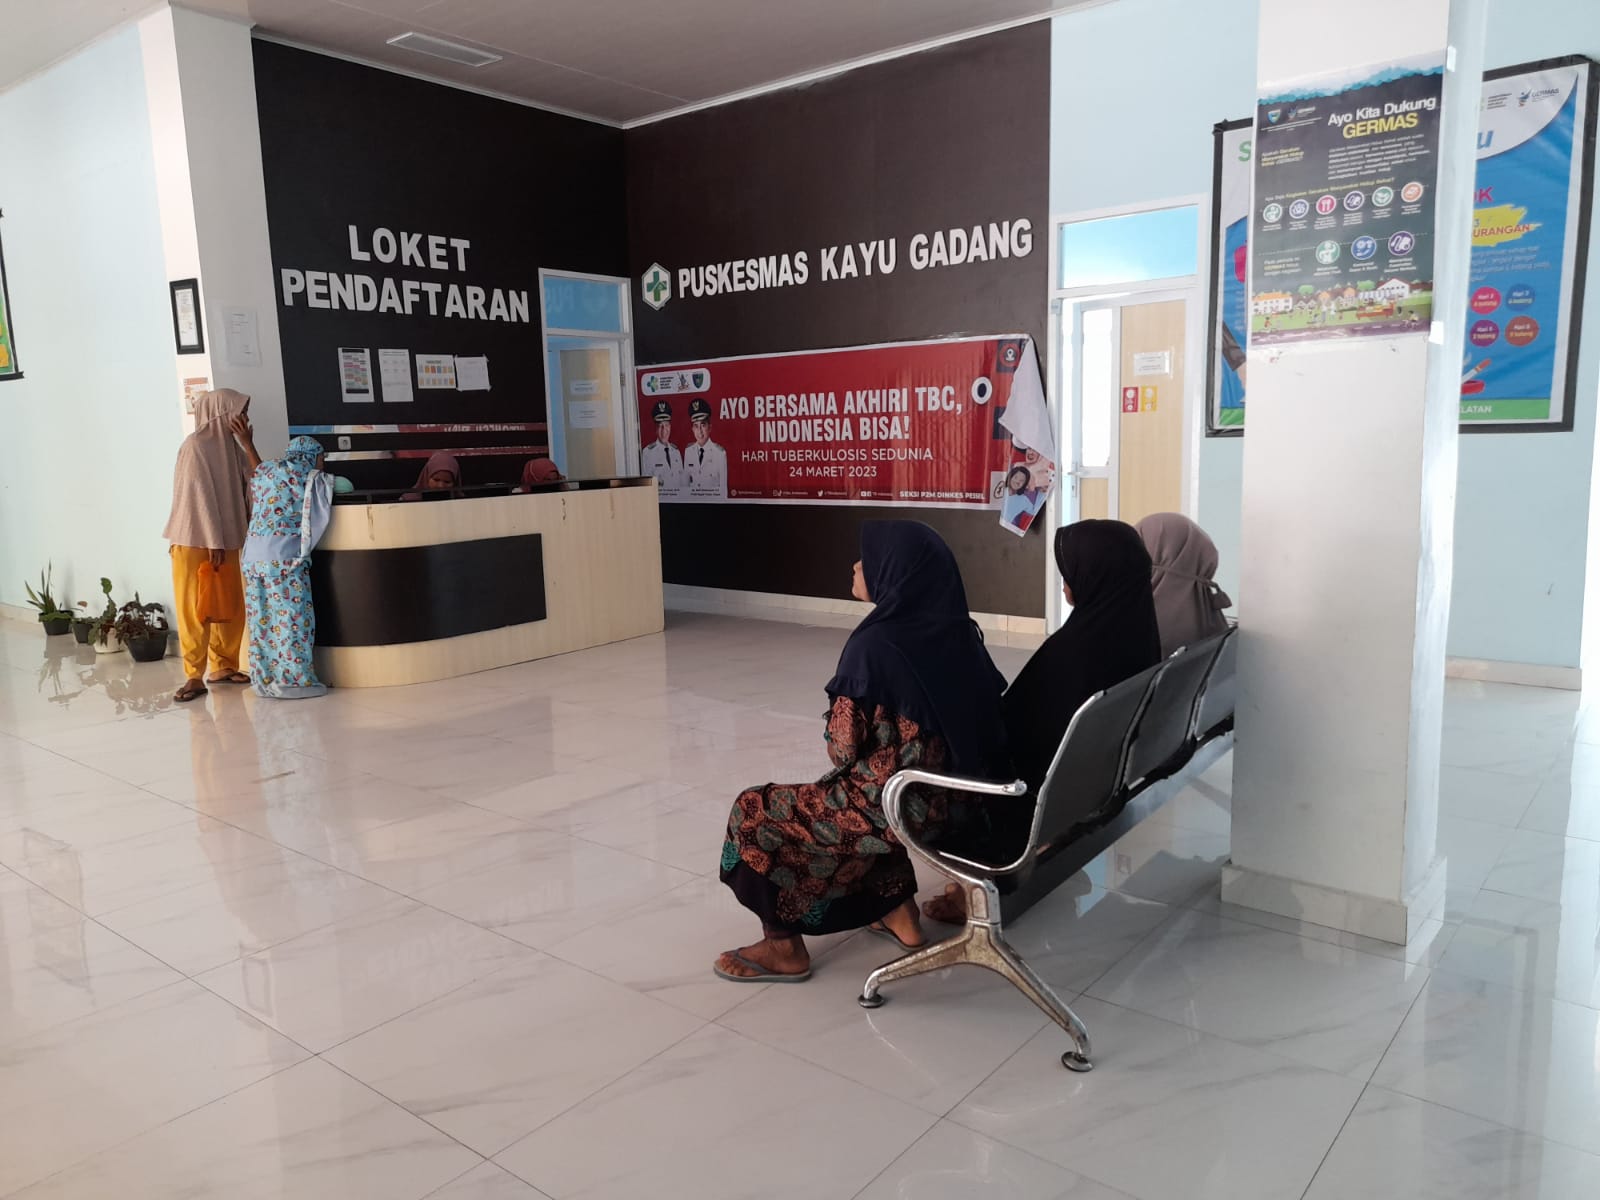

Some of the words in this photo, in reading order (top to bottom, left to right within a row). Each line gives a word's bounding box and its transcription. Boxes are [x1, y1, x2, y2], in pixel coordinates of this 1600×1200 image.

[1328, 113, 1353, 127] Ayo
[1356, 107, 1381, 121] Kita
[1384, 97, 1437, 116] Dukung
[1343, 112, 1419, 139] GERMAS
[348, 224, 470, 272] LOKET
[678, 251, 809, 299] PUSKESMAS
[820, 238, 897, 281] KAYU
[909, 218, 1033, 271] GADANG
[281, 268, 530, 323] PENDAFTARAN
[719, 396, 749, 420] AYO
[754, 391, 838, 419] BERSAMA
[844, 388, 909, 414] AKHIRI
[915, 385, 962, 416] TBC,
[1459, 405, 1492, 414] LATAN
[759, 416, 854, 443] INDONESIA
[859, 416, 910, 441] BISA!
[741, 450, 769, 463] HARI
[772, 448, 867, 462] TUBERKULOSIS
[871, 447, 933, 461] SEDUNIA
[789, 466, 803, 478] 24
[806, 466, 846, 477] MARET
[849, 466, 878, 478] 2023
